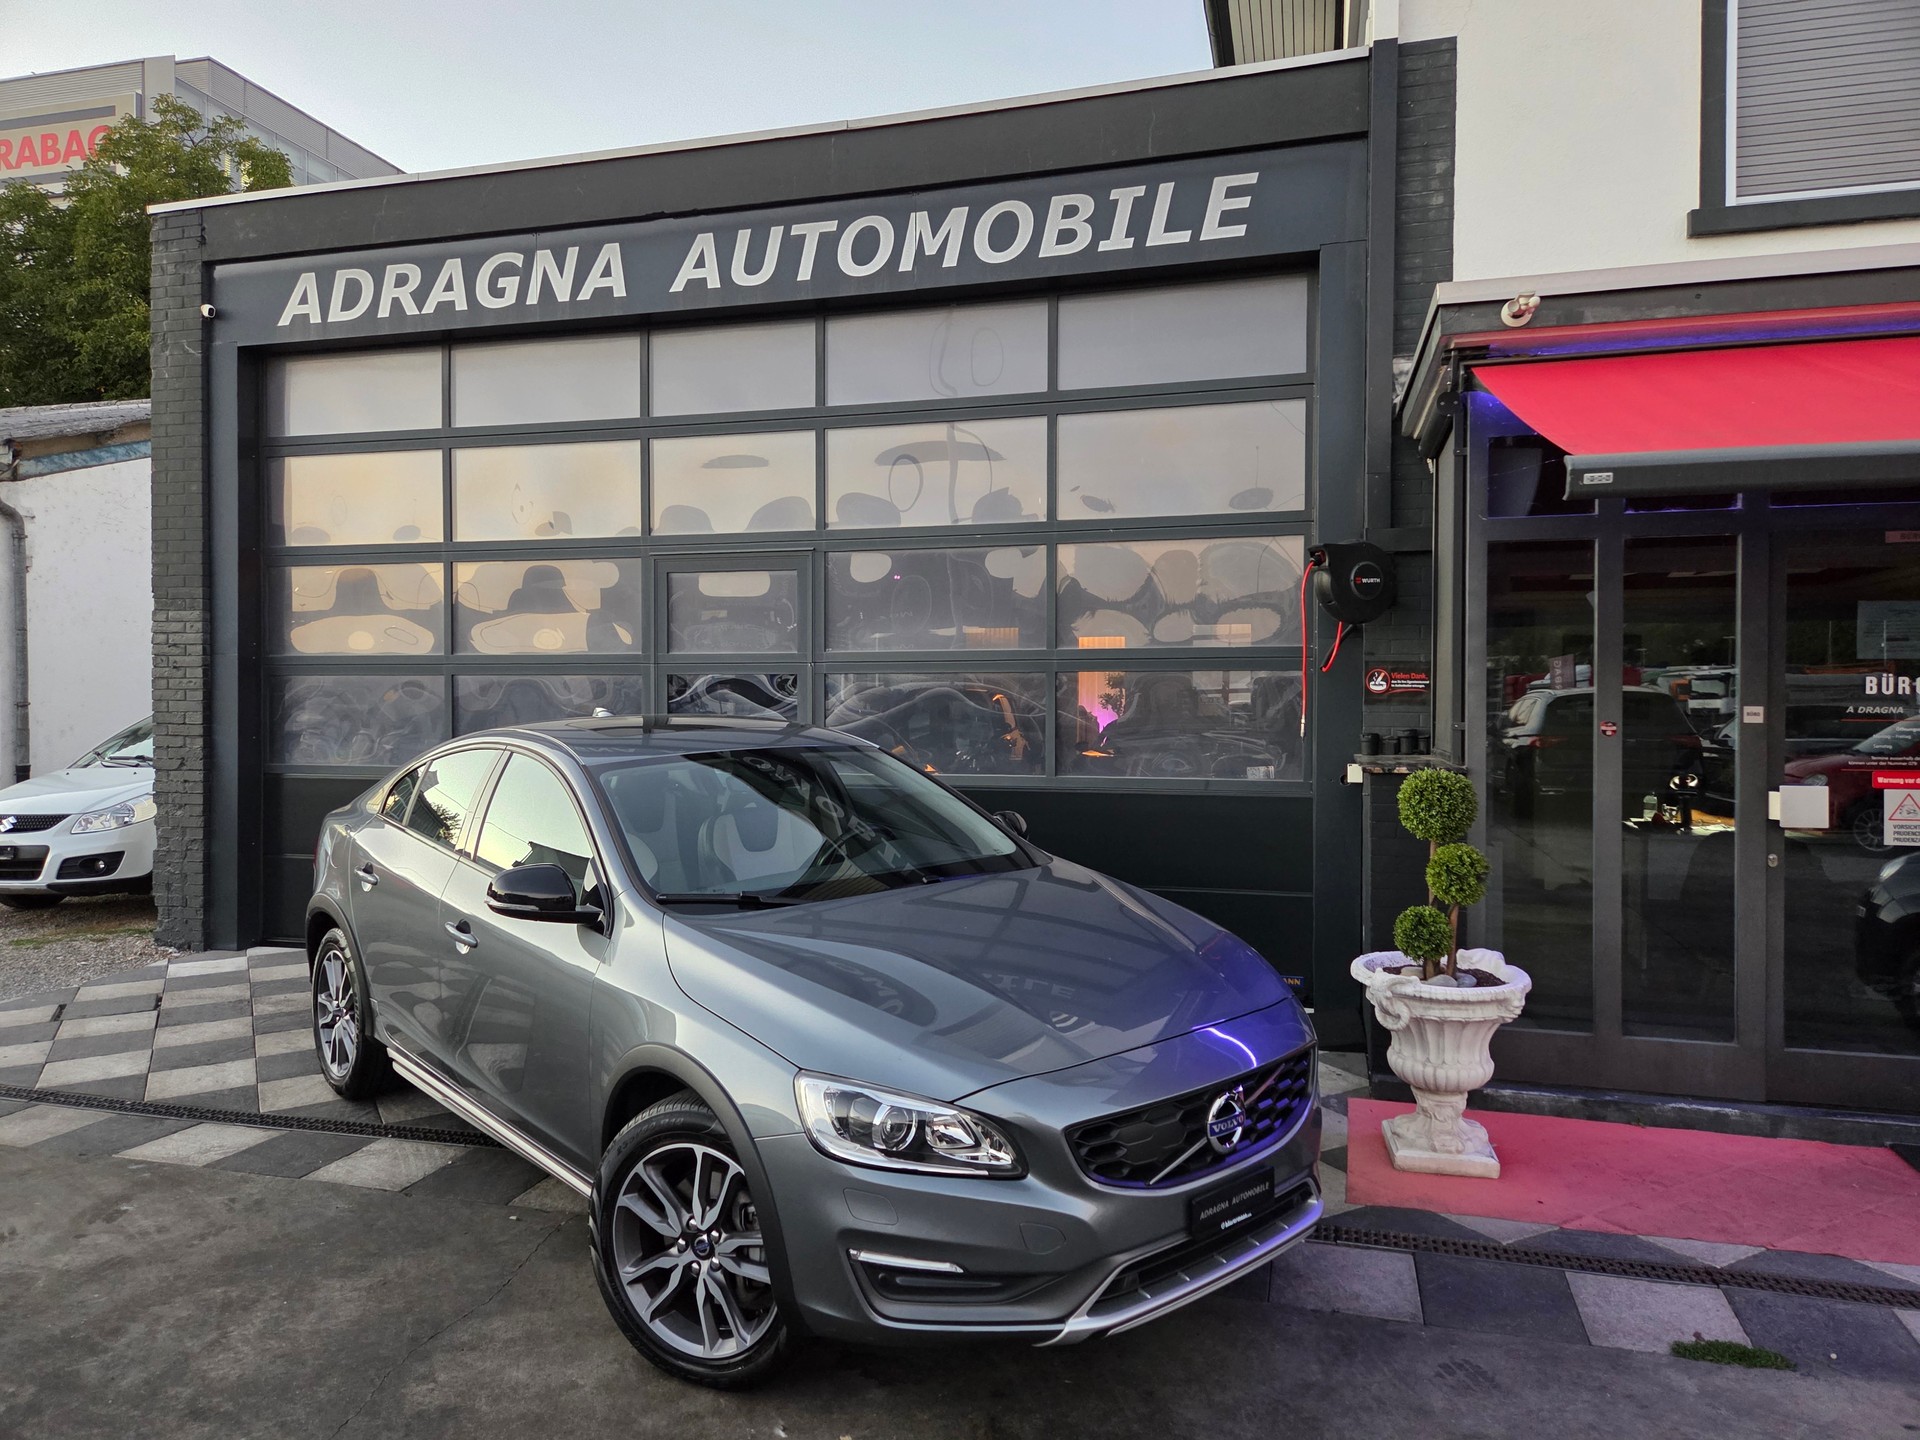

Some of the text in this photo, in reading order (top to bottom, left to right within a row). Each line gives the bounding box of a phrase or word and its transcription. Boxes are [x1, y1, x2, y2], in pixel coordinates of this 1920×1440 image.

[277, 171, 1260, 327] ADRAGNA AUTOMOBILE
[1857, 706, 1904, 714] DRAGNA
[1877, 776, 1904, 785] Warnung
[1212, 1116, 1244, 1133] VOLVO
[1199, 1181, 1270, 1220] ADRAGNA AUTOMOBILE
